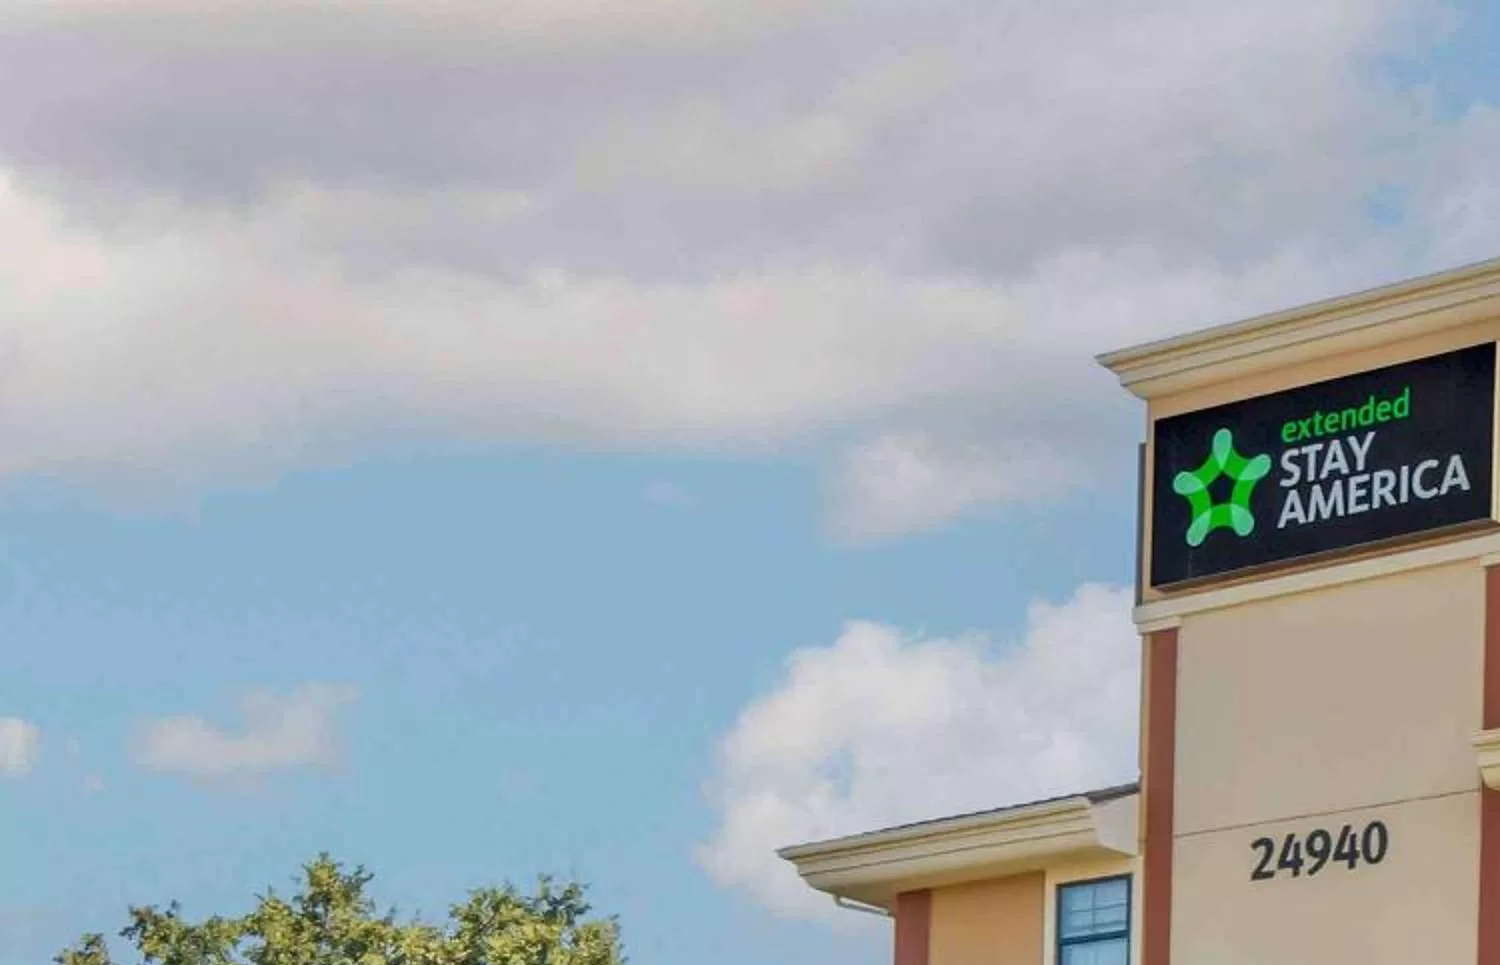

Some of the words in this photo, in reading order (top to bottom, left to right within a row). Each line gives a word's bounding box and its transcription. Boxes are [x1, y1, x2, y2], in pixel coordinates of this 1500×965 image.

[1281, 387, 1410, 443] extended
[1279, 431, 1377, 487] STAY
[1277, 455, 1471, 528] AMERICA
[1250, 820, 1389, 881] 24940
